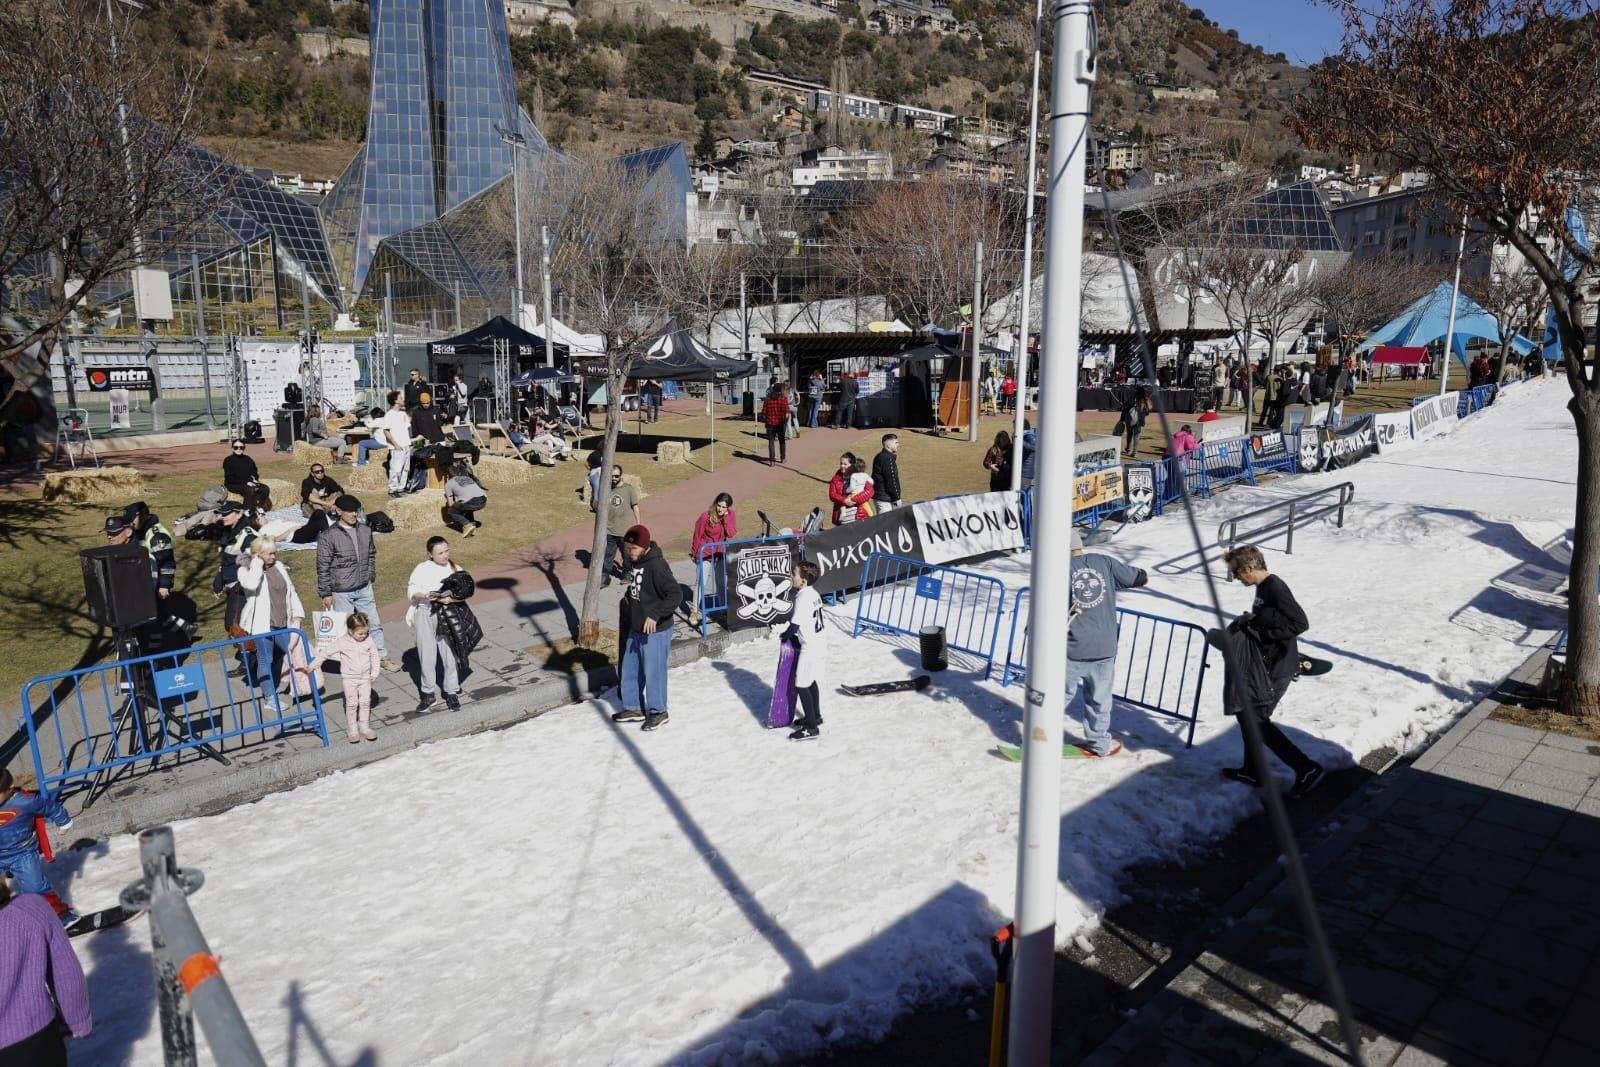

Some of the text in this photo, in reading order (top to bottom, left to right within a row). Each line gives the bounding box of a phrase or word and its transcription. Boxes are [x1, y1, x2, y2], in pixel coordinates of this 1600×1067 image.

[110, 369, 148, 381] mtn
[587, 366, 609, 375] NIXO
[926, 510, 1001, 545] NIXON
[816, 530, 895, 577] NIXON
[739, 556, 791, 579] SLIDEWAYZ
